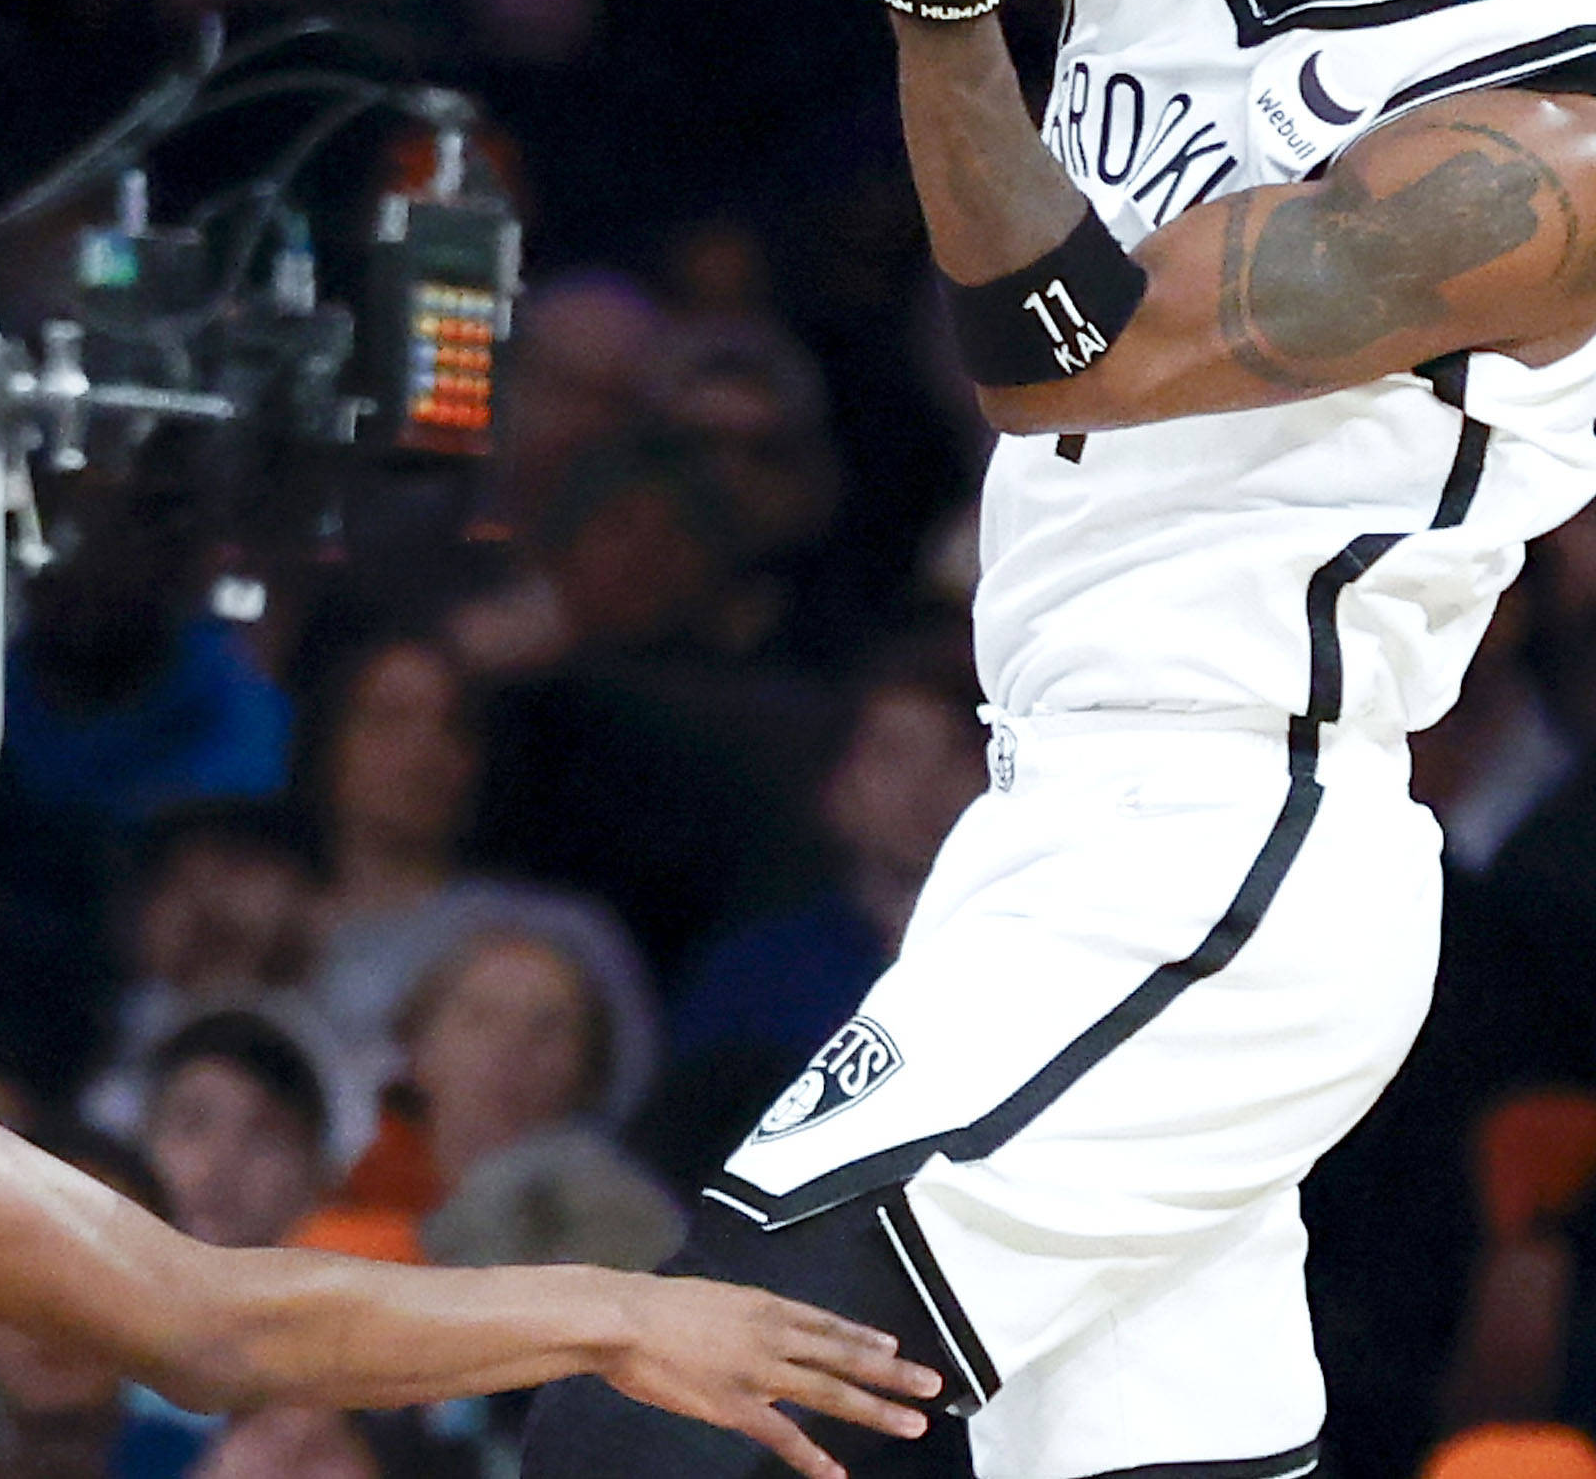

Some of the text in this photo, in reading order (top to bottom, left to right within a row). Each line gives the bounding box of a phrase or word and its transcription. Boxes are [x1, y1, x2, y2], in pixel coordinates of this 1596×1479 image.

[1257, 88, 1316, 160] Webull
[1022, 278, 1086, 344] 11
[1054, 321, 1109, 375] KAI
[808, 1021, 890, 1097] ETS
